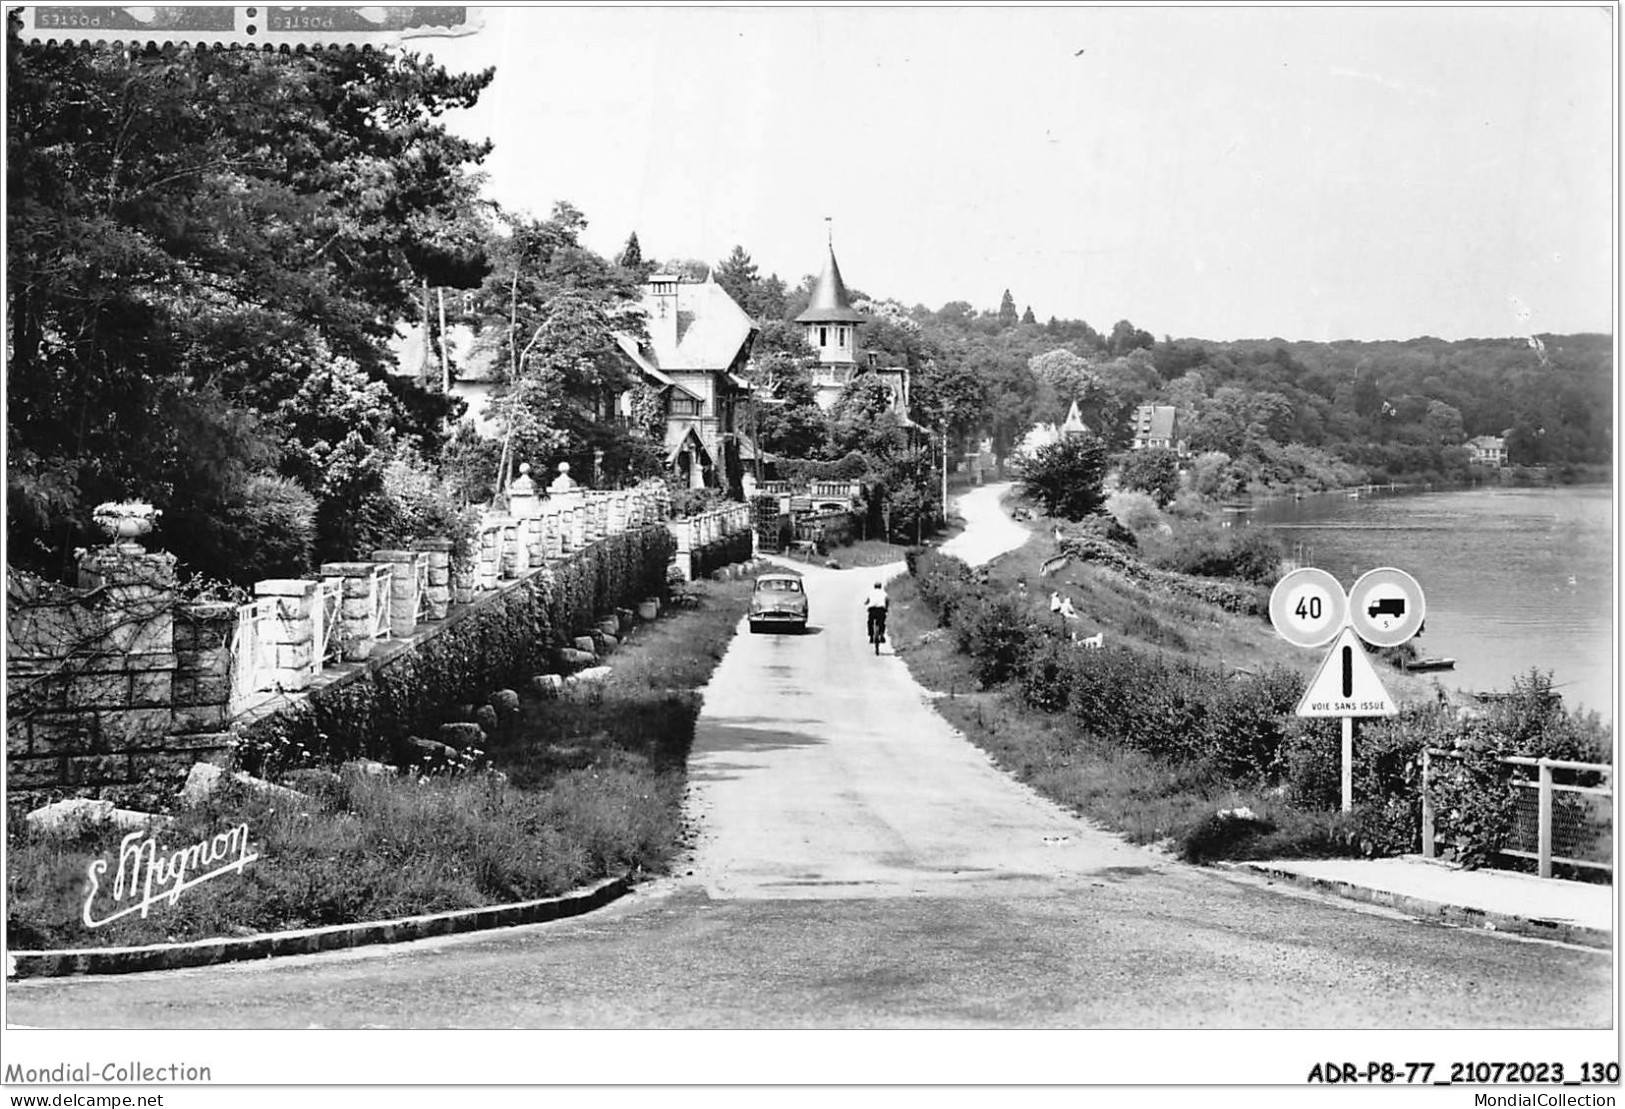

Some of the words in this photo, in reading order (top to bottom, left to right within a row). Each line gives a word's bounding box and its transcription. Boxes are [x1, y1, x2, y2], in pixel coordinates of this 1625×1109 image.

[41, 14, 100, 26] POSTES
[272, 16, 332, 28] POSTES
[1295, 596, 1321, 619] 40
[1312, 702, 1329, 710] VOIE
[1335, 702, 1356, 710] SANS
[1361, 701, 1384, 710] ISSUE
